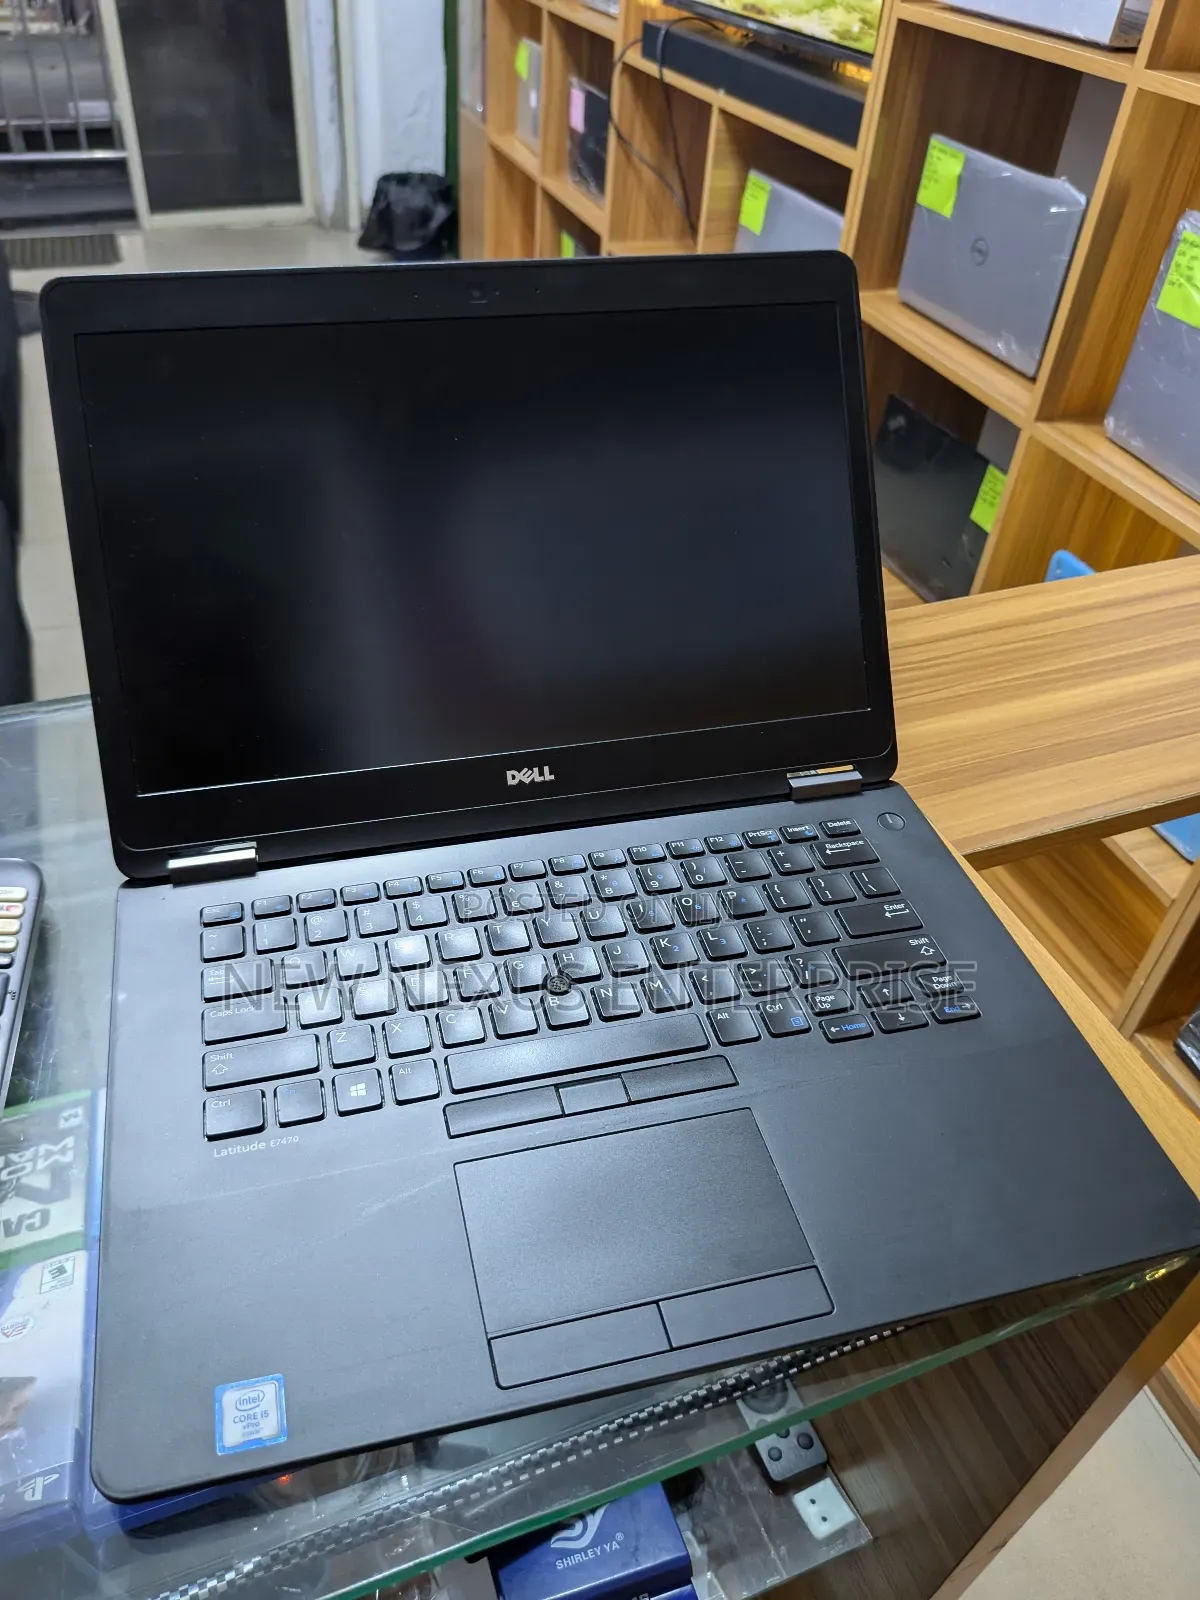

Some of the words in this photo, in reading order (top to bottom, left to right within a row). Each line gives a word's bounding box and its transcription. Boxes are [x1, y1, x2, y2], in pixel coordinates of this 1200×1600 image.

[506, 765, 555, 786] DELL
[827, 820, 852, 828] Delete
[748, 829, 774, 838] PrtScr
[787, 825, 810, 833] Insert
[825, 839, 865, 850] Backspace
[695, 874, 704, 882] 0
[650, 880, 659, 888] 9
[604, 887, 614, 895] 8
[727, 891, 737, 899] P
[459, 894, 470, 902] %
[681, 897, 693, 906] O
[256, 899, 268, 907] F1
[412, 901, 420, 909] $
[511, 900, 519, 908] 6
[884, 902, 906, 912] Enter
[205, 907, 221, 915] Esc
[362, 909, 371, 917] #
[588, 910, 599, 920] U
[310, 915, 323, 926] @
[415, 914, 423, 922] 4
[541, 918, 551, 927] Y
[365, 922, 373, 931] 3
[492, 925, 502, 934] T
[314, 930, 323, 938] 2
[444, 933, 455, 942] R
[707, 931, 718, 941] L
[659, 938, 672, 948] K
[909, 937, 930, 946] Shift
[340, 948, 357, 958] W
[612, 946, 622, 955] J
[562, 952, 574, 962] H
[512, 960, 524, 970] G
[796, 958, 804, 968] ?
[209, 968, 225, 976] Tab
[463, 969, 473, 979] F
[648, 980, 663, 990] M
[933, 982, 958, 990] Down
[600, 987, 613, 998] N
[549, 996, 560, 1006] B
[815, 995, 835, 1003] Page
[498, 1004, 509, 1014] V
[766, 1003, 783, 1012] Ctrl
[944, 1005, 960, 1013] End
[210, 1008, 234, 1018] Caps
[717, 1012, 730, 1020] Alt
[445, 1013, 456, 1024] C
[391, 1023, 403, 1033] X
[841, 1021, 867, 1031] Home
[336, 1032, 347, 1043] Z
[210, 1052, 234, 1062] Shift
[399, 1067, 412, 1075] Alt
[211, 1099, 231, 1108] Ctrl
[213, 1141, 266, 1158] Latitude
[270, 1135, 299, 1147] E7470
[0, 1207, 50, 1238] CA
[239, 1392, 262, 1406] intel
[233, 1411, 258, 1424] CORE
[242, 1421, 260, 1430] vPro
[555, 1545, 602, 1570] SHIRLEY
